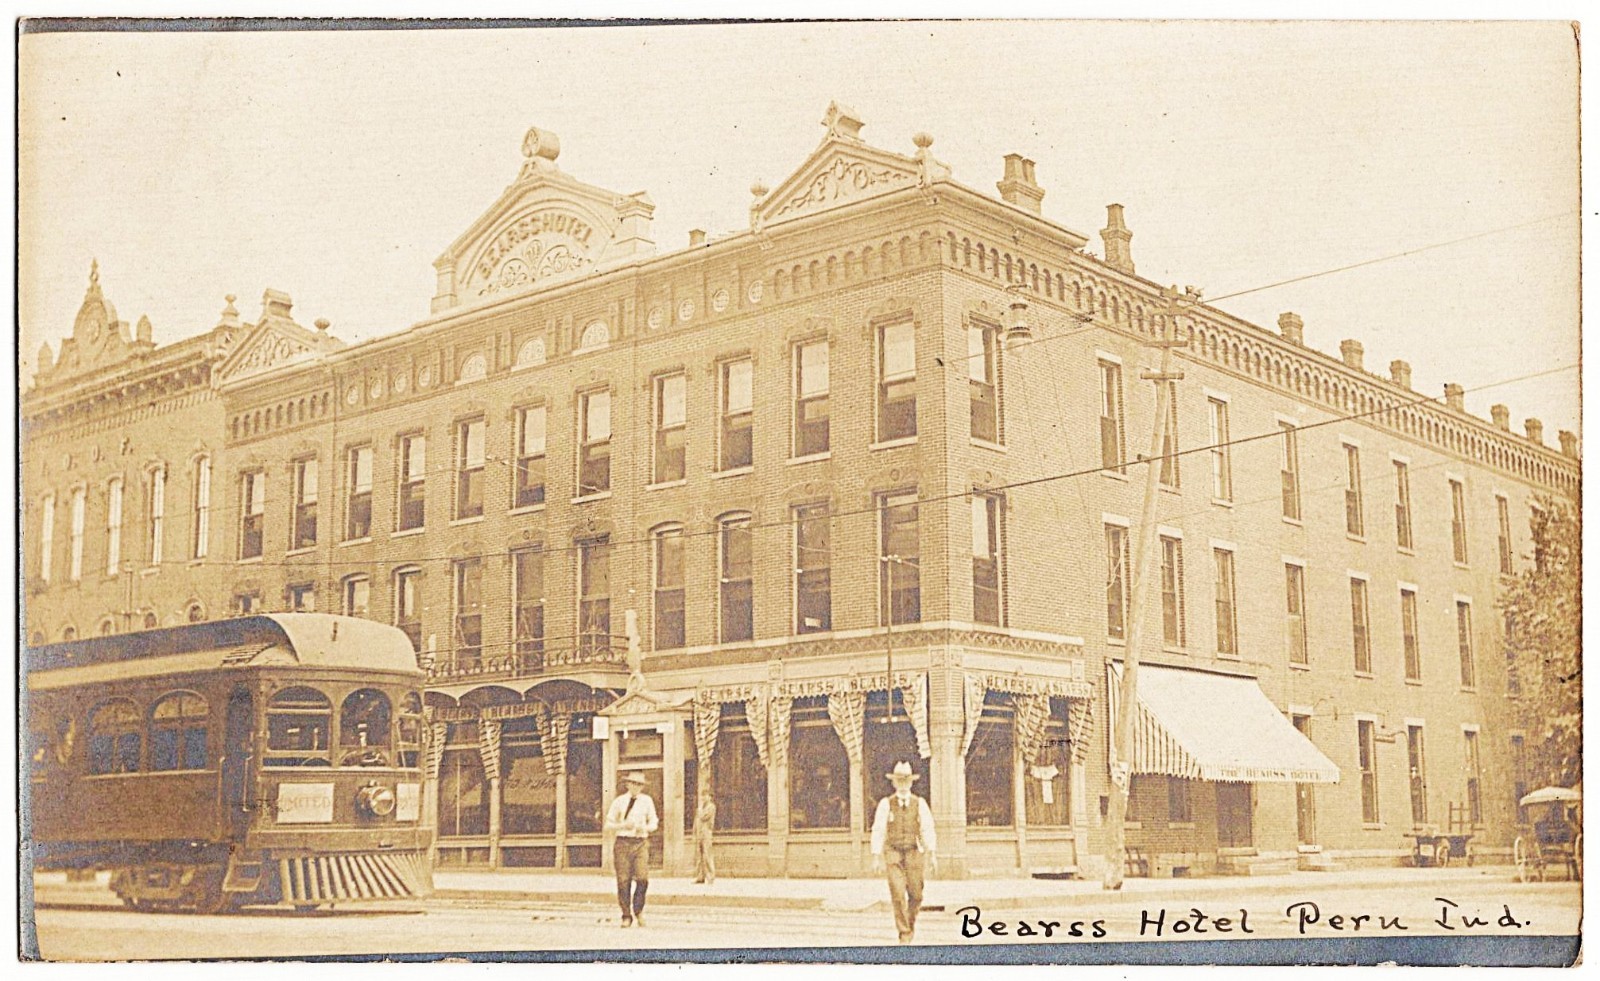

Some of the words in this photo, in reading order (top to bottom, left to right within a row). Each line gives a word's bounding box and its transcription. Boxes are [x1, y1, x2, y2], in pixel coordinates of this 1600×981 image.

[701, 686, 751, 701] BEARSS
[779, 681, 834, 695] BEARSS
[1245, 768, 1287, 778] BEARSS
